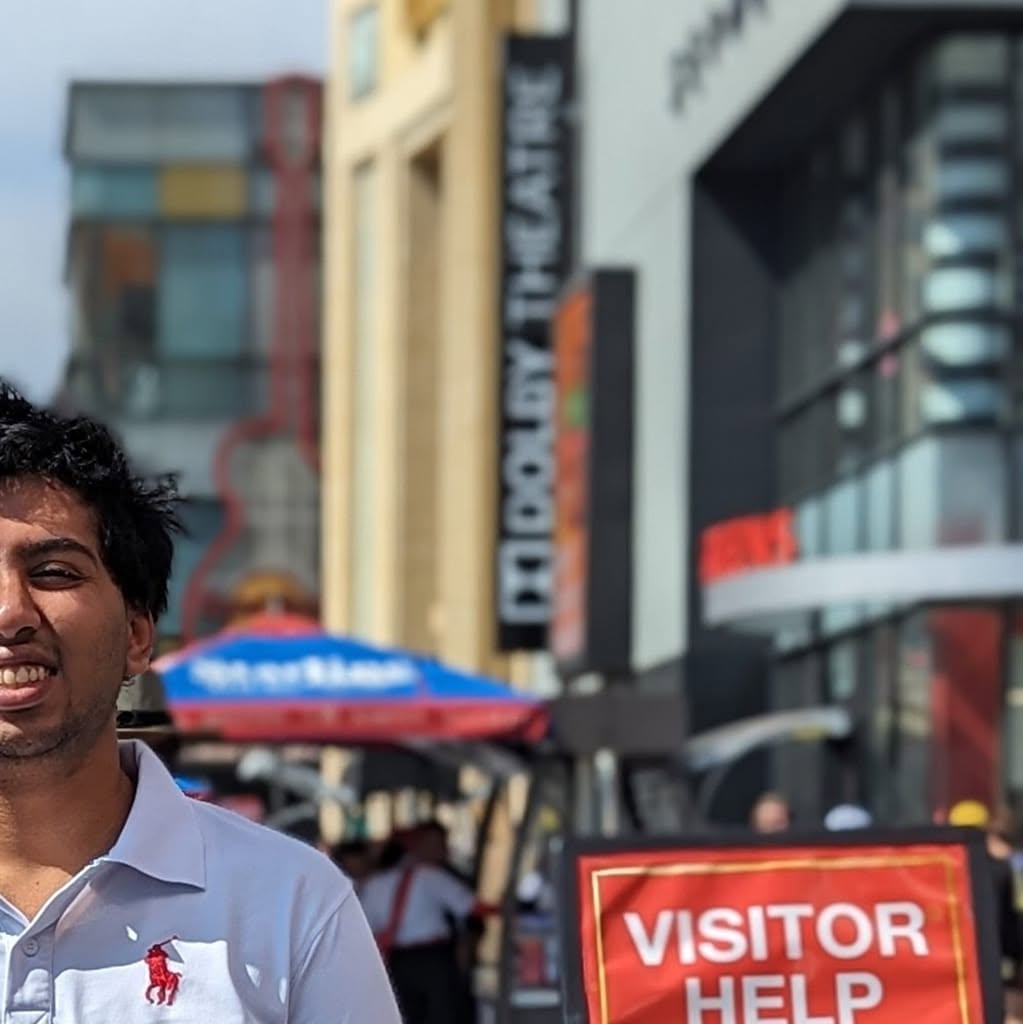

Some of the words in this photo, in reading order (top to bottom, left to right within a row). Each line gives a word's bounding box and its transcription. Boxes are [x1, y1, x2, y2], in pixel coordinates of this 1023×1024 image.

[505, 62, 565, 328] THEATRE
[501, 338, 555, 534] DOLBY
[623, 901, 929, 967] VISITOR
